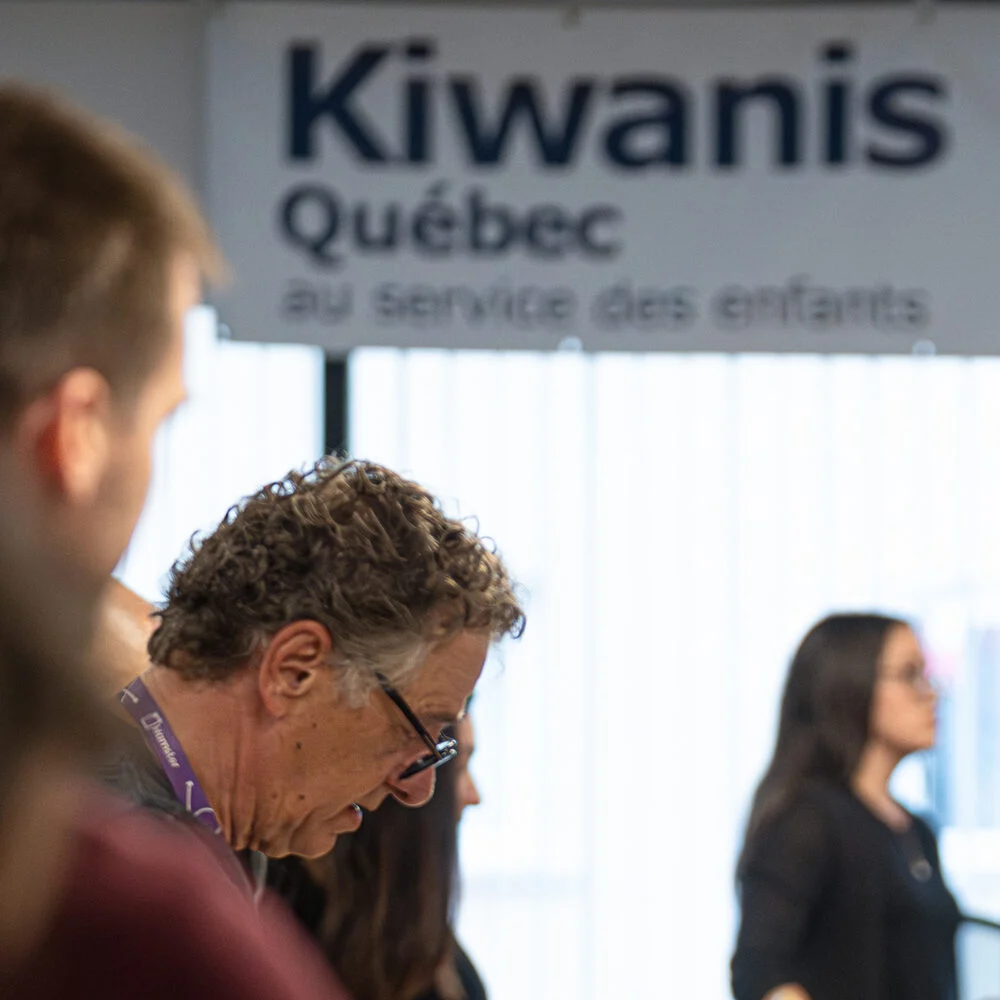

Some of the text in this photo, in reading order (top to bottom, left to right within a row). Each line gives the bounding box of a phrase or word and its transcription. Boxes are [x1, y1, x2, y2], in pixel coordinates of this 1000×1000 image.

[284, 40, 951, 171] Kiwanis
[278, 182, 624, 267] Québec
[281, 275, 929, 329] au service des enfants
